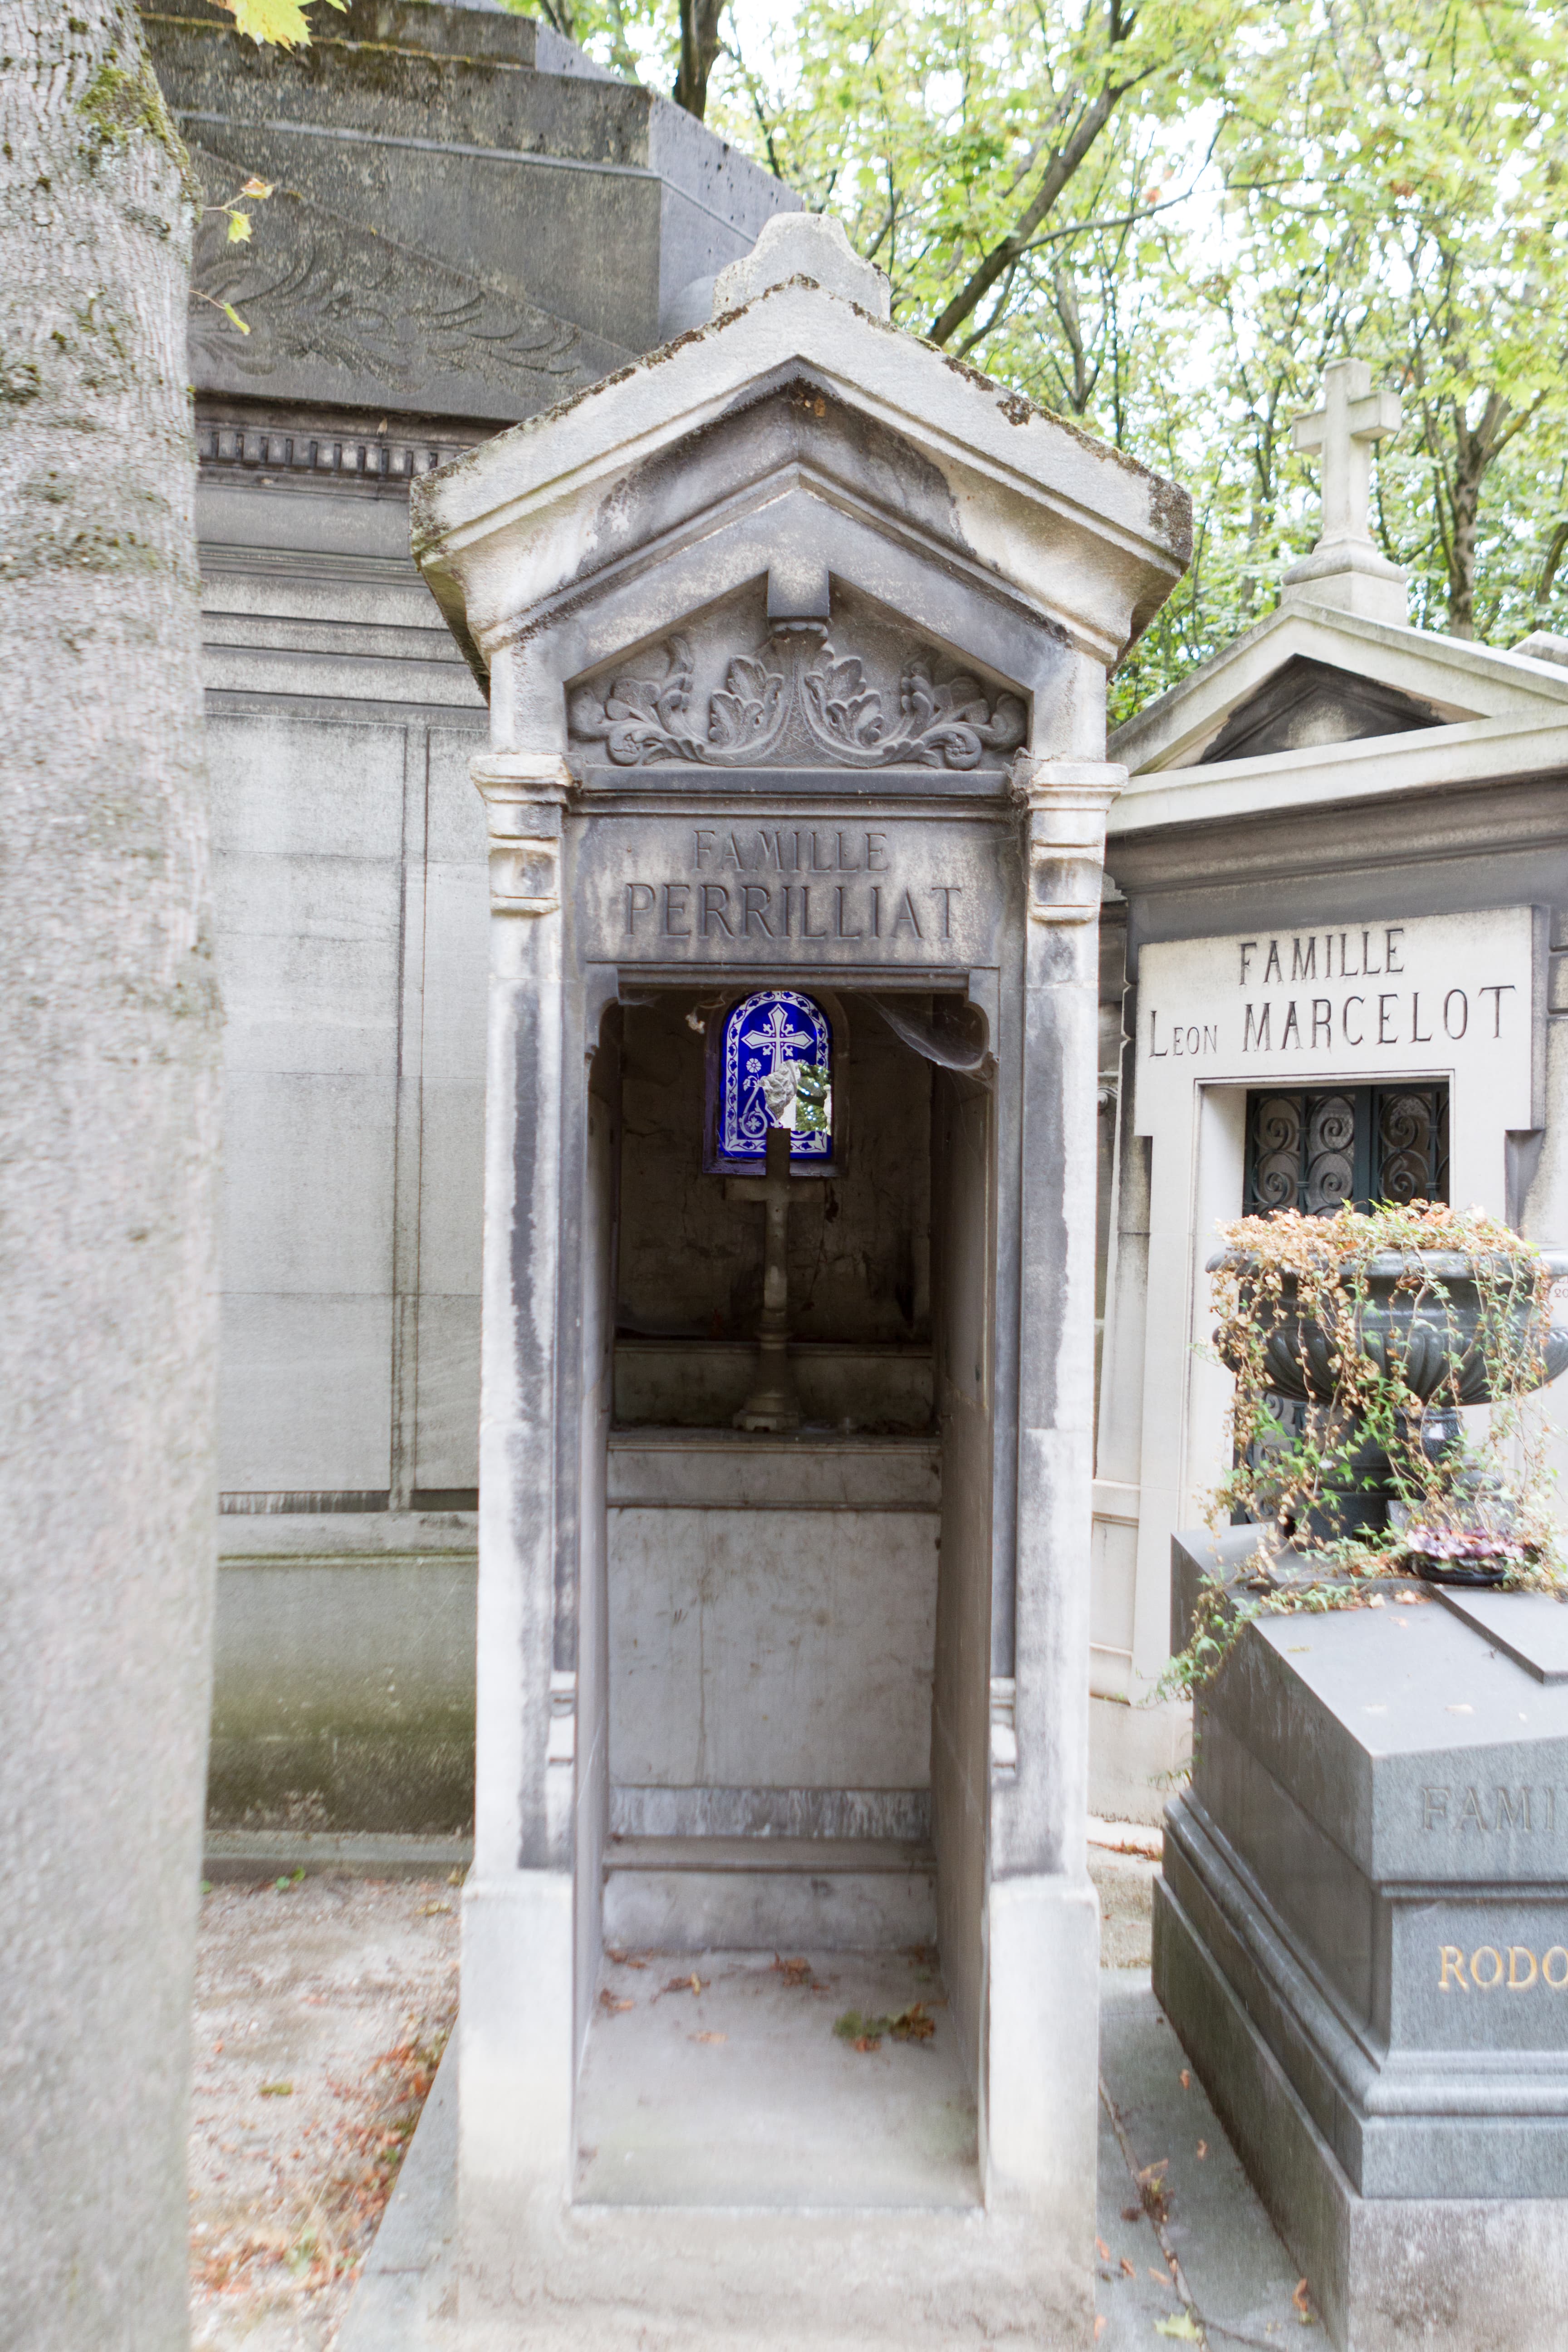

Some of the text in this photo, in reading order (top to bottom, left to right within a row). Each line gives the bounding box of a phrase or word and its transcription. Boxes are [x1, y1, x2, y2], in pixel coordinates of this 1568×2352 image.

[692, 829, 891, 873] FAMILLE
[623, 882, 963, 942] PERRILLIAT
[1238, 928, 1405, 986] FAMILLE
[1242, 985, 1516, 1053] MARCELOT
